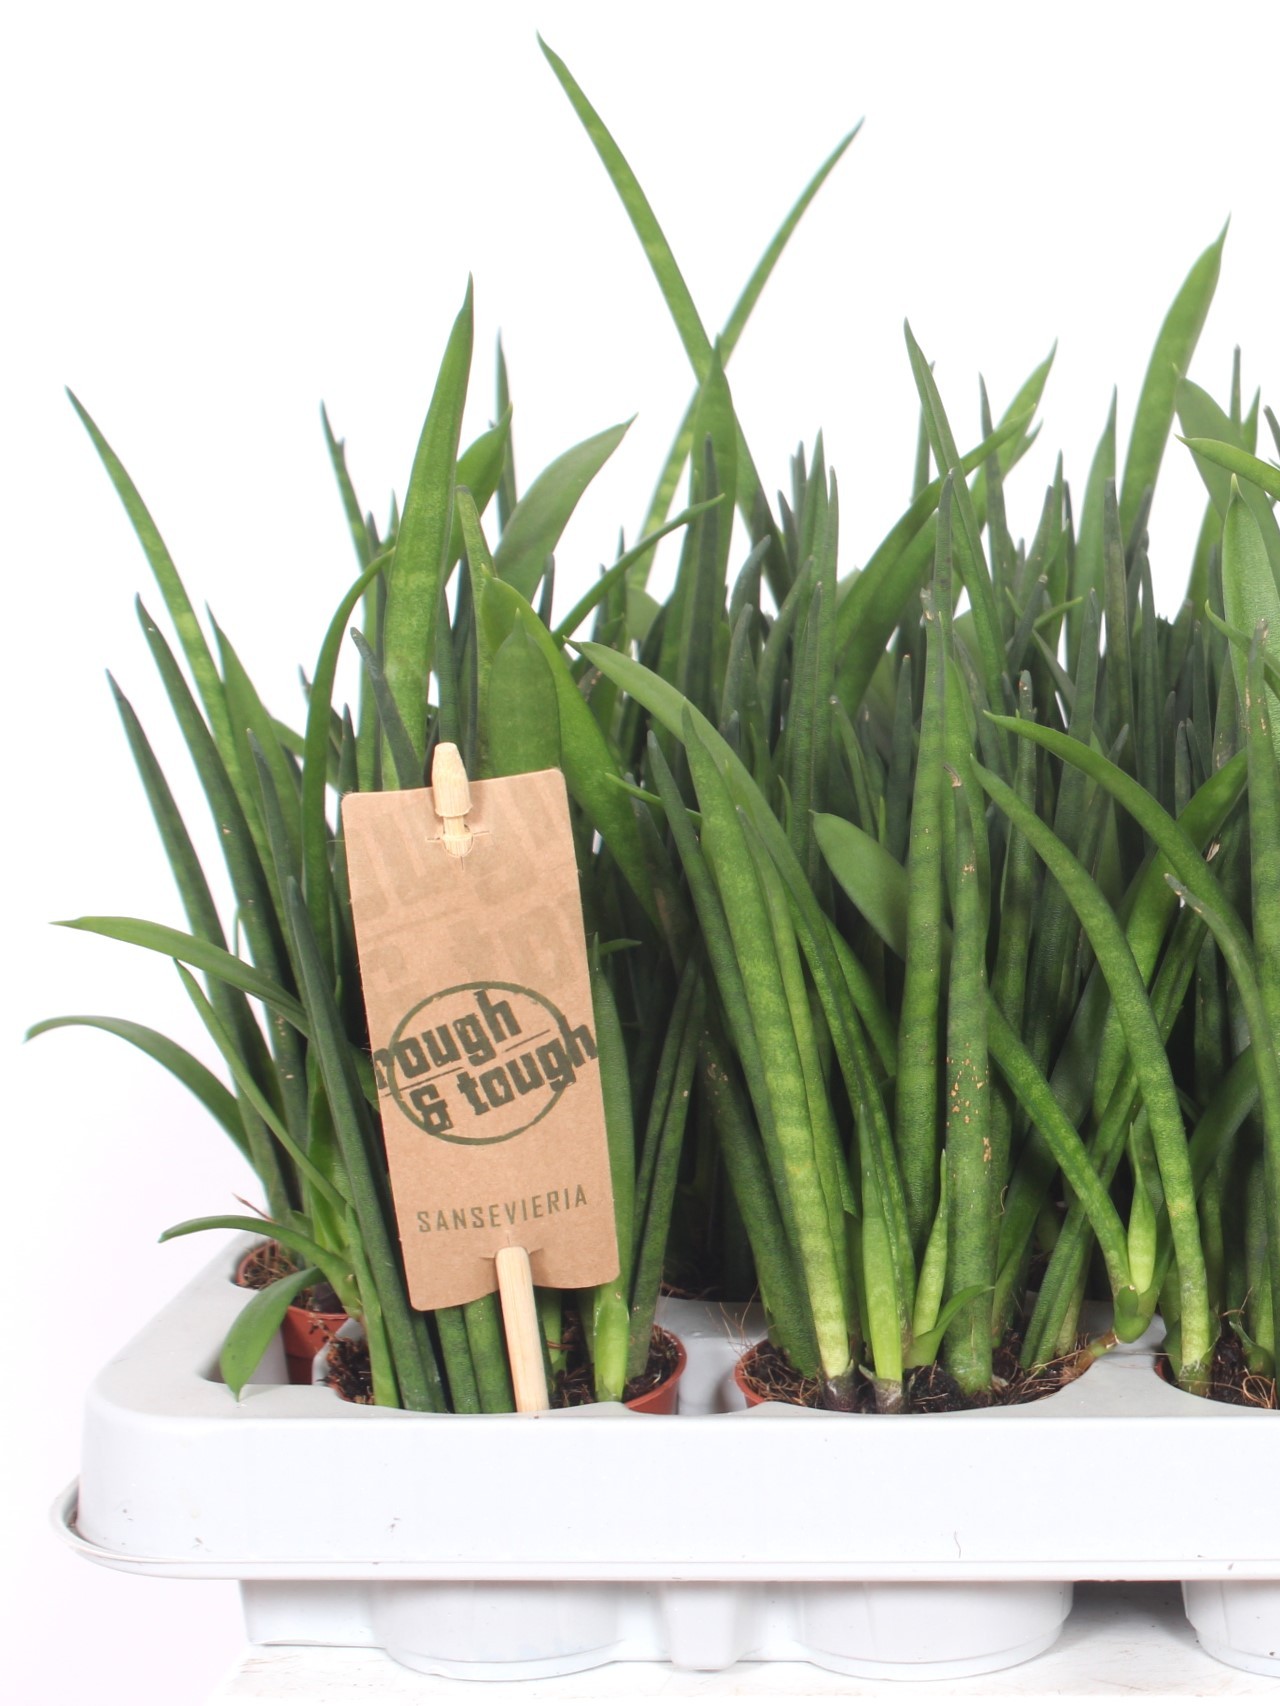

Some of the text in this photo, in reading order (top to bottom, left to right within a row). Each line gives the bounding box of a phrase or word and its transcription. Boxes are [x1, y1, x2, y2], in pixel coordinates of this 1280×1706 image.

[373, 989, 522, 1090] rough
[409, 1014, 598, 1135] & tough
[416, 1183, 588, 1233] SANSEVIERIA
